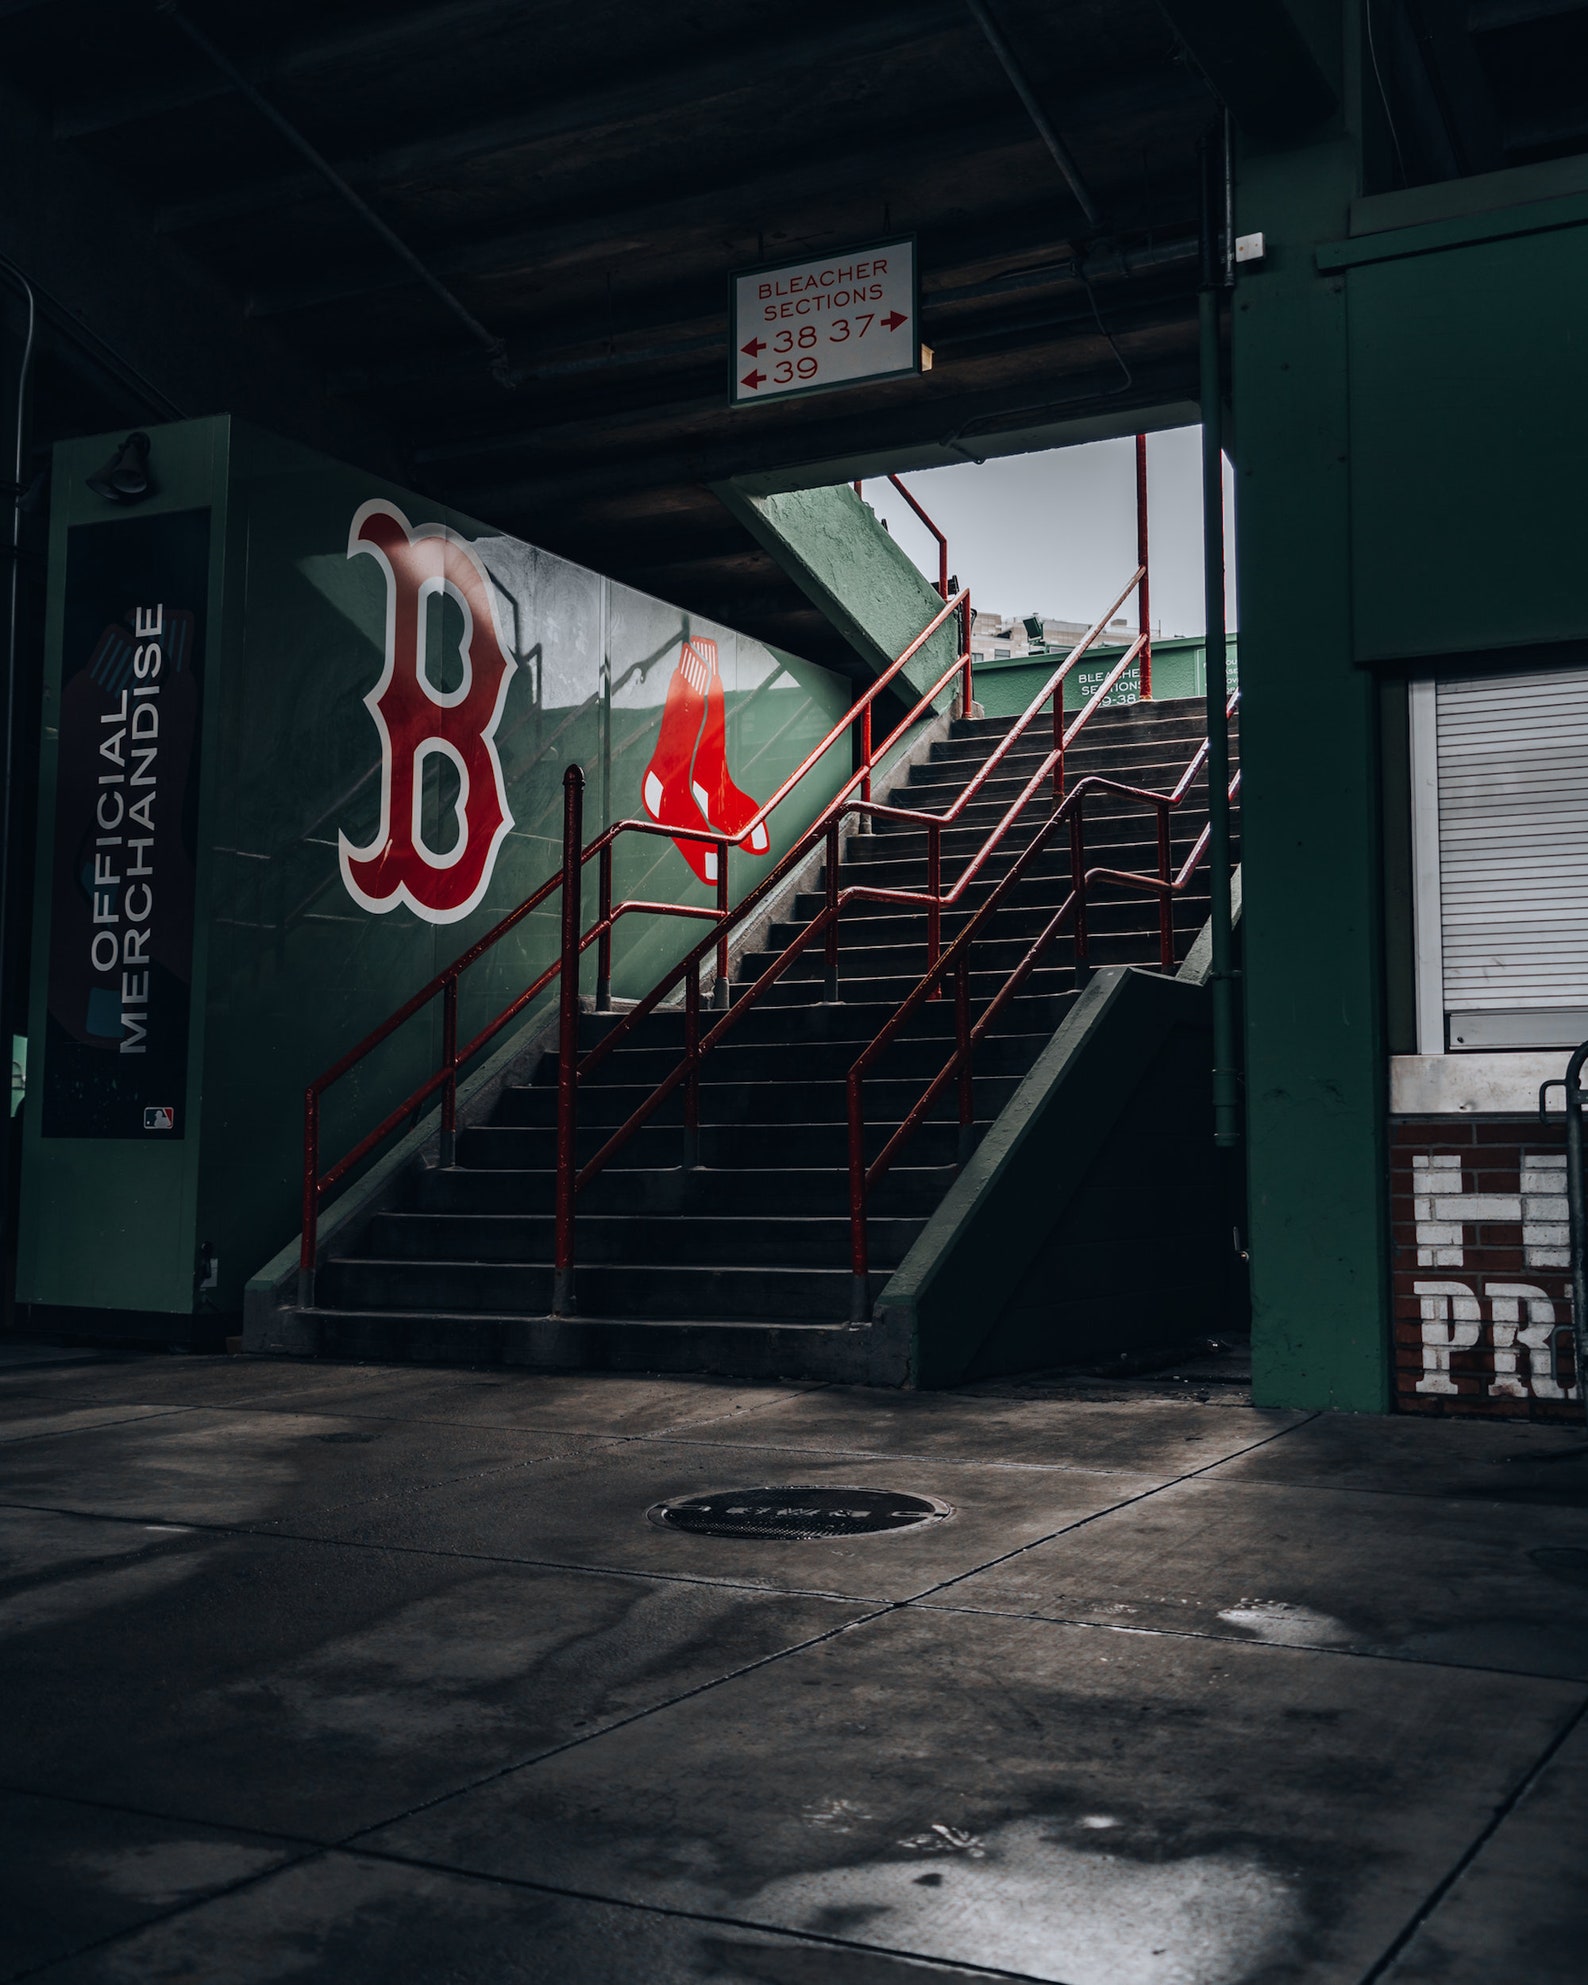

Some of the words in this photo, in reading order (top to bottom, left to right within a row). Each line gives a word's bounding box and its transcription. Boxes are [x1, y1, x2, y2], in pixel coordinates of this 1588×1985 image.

[758, 259, 887, 299] BLEACHER
[764, 284, 883, 321] SECTIONS
[773, 326, 817, 353] 38
[829, 314, 875, 343] 37
[773, 357, 818, 384] 39
[1078, 668, 1140, 684] BLEHE
[1081, 680, 1141, 696] SEION
[1097, 693, 1136, 707] 9-38
[90, 687, 128, 973] OFFICIAL
[119, 602, 164, 1054] MERCHANDISE
